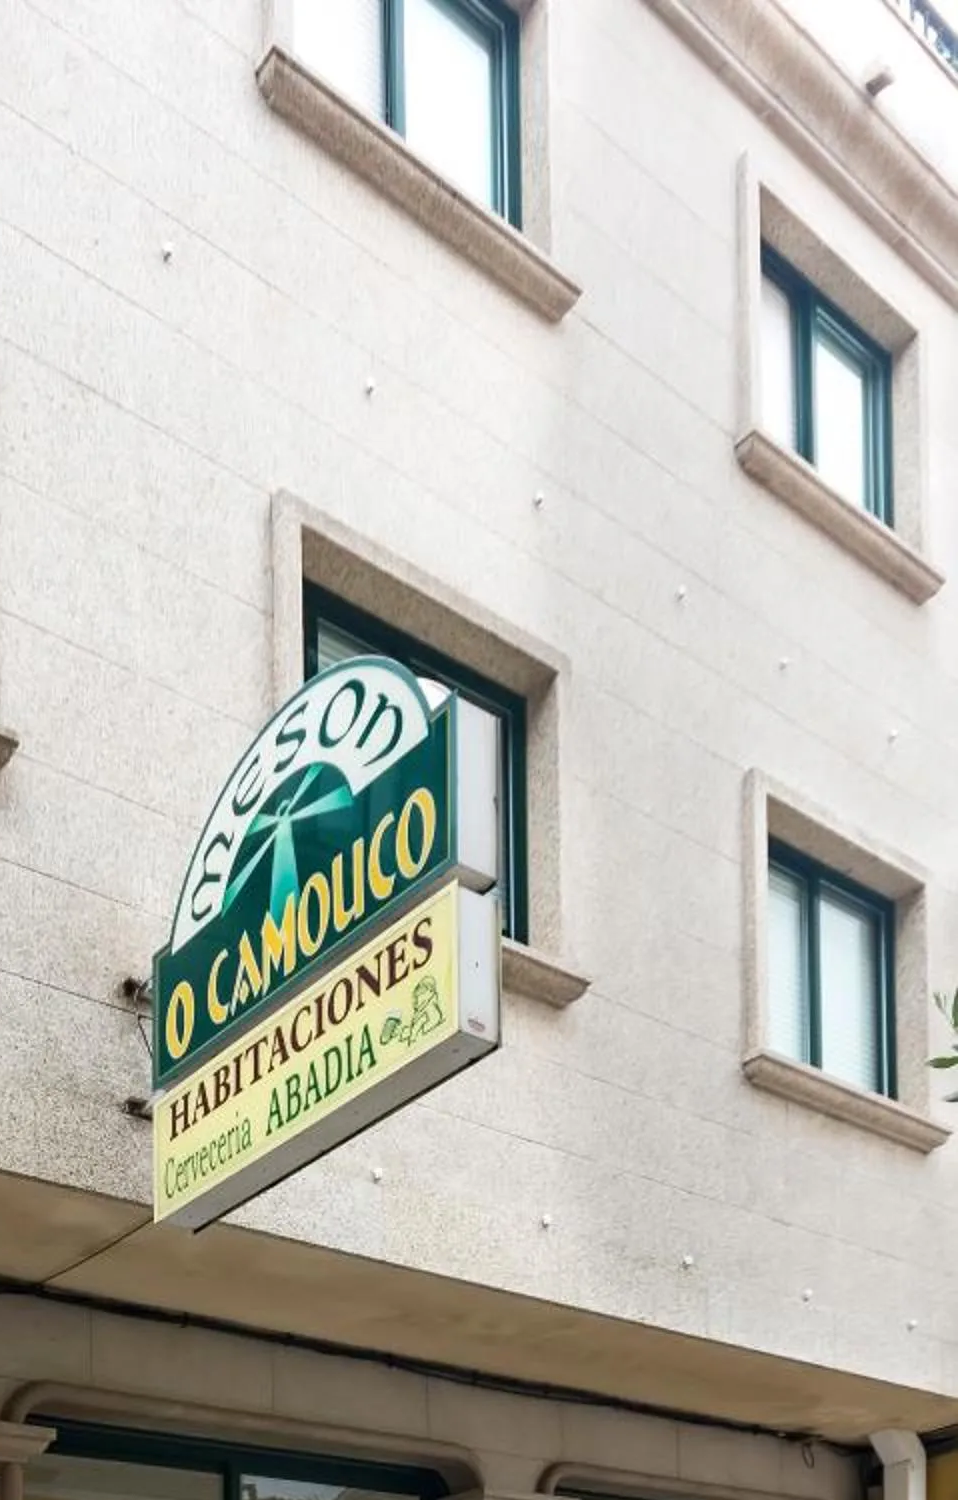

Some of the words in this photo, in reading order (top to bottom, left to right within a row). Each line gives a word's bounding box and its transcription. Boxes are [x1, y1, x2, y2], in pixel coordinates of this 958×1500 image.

[165, 981, 195, 1059] O
[207, 786, 437, 1025] CAMOUCO
[169, 917, 434, 1141] HABITACIONES
[265, 1023, 377, 1137] ABADIA
